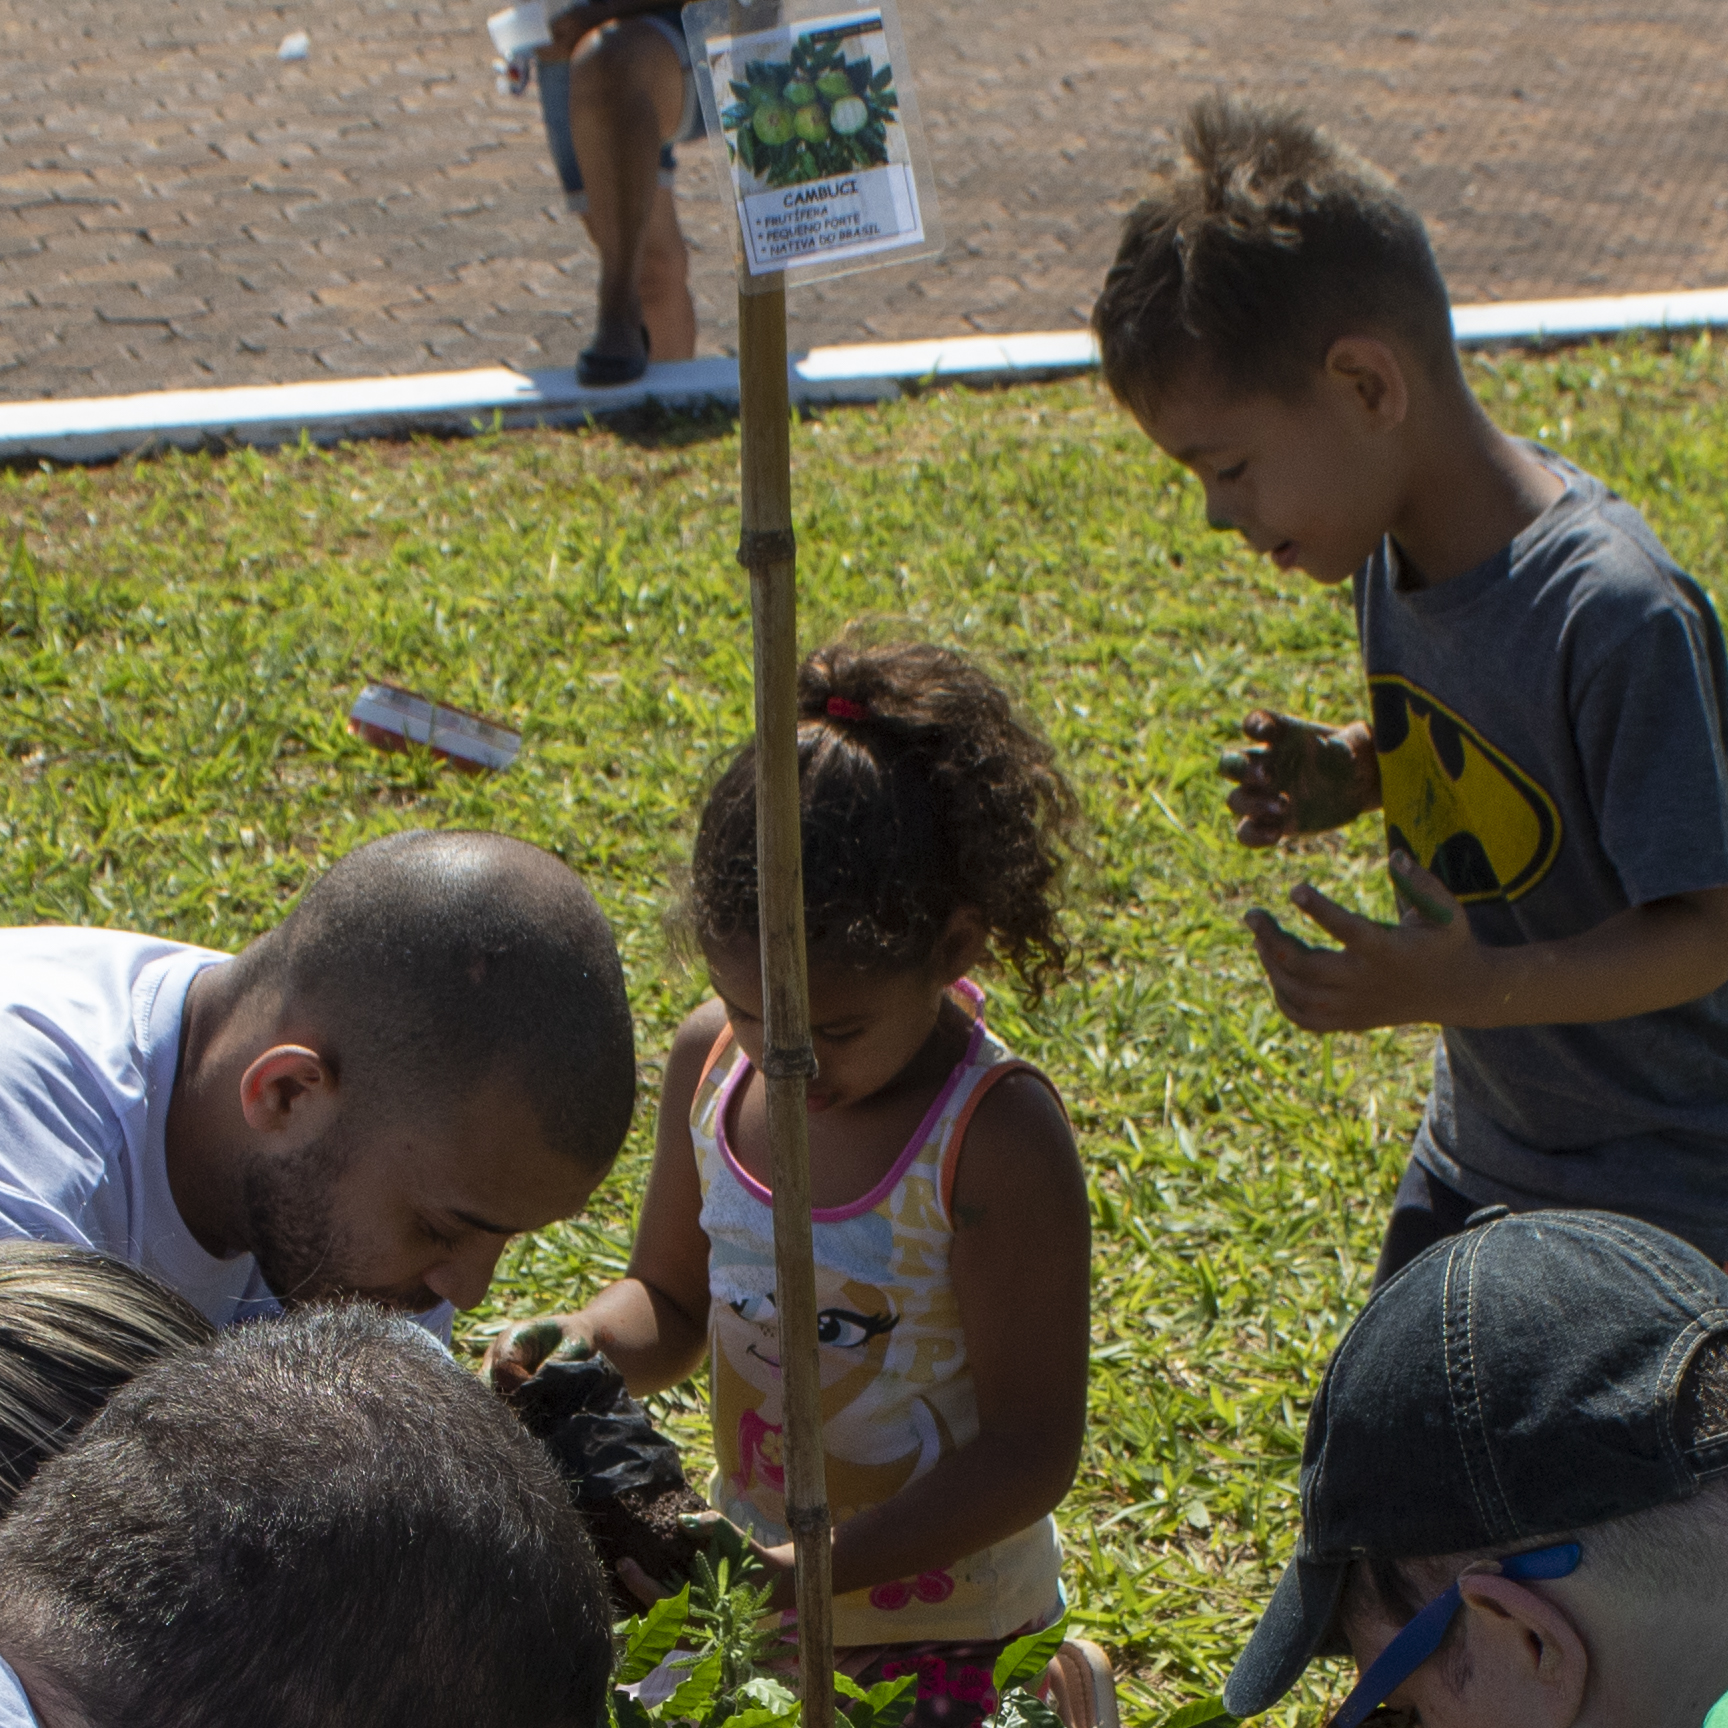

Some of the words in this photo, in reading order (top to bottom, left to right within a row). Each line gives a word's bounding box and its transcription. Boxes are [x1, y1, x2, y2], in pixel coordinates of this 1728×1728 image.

[783, 180, 859, 208] CAMBUCI
[767, 221, 822, 242] PEQUENO
[824, 211, 861, 231] PORTE
[770, 236, 816, 256] NATIVA
[818, 232, 836, 246] DO
[839, 222, 881, 242] BRASIL
